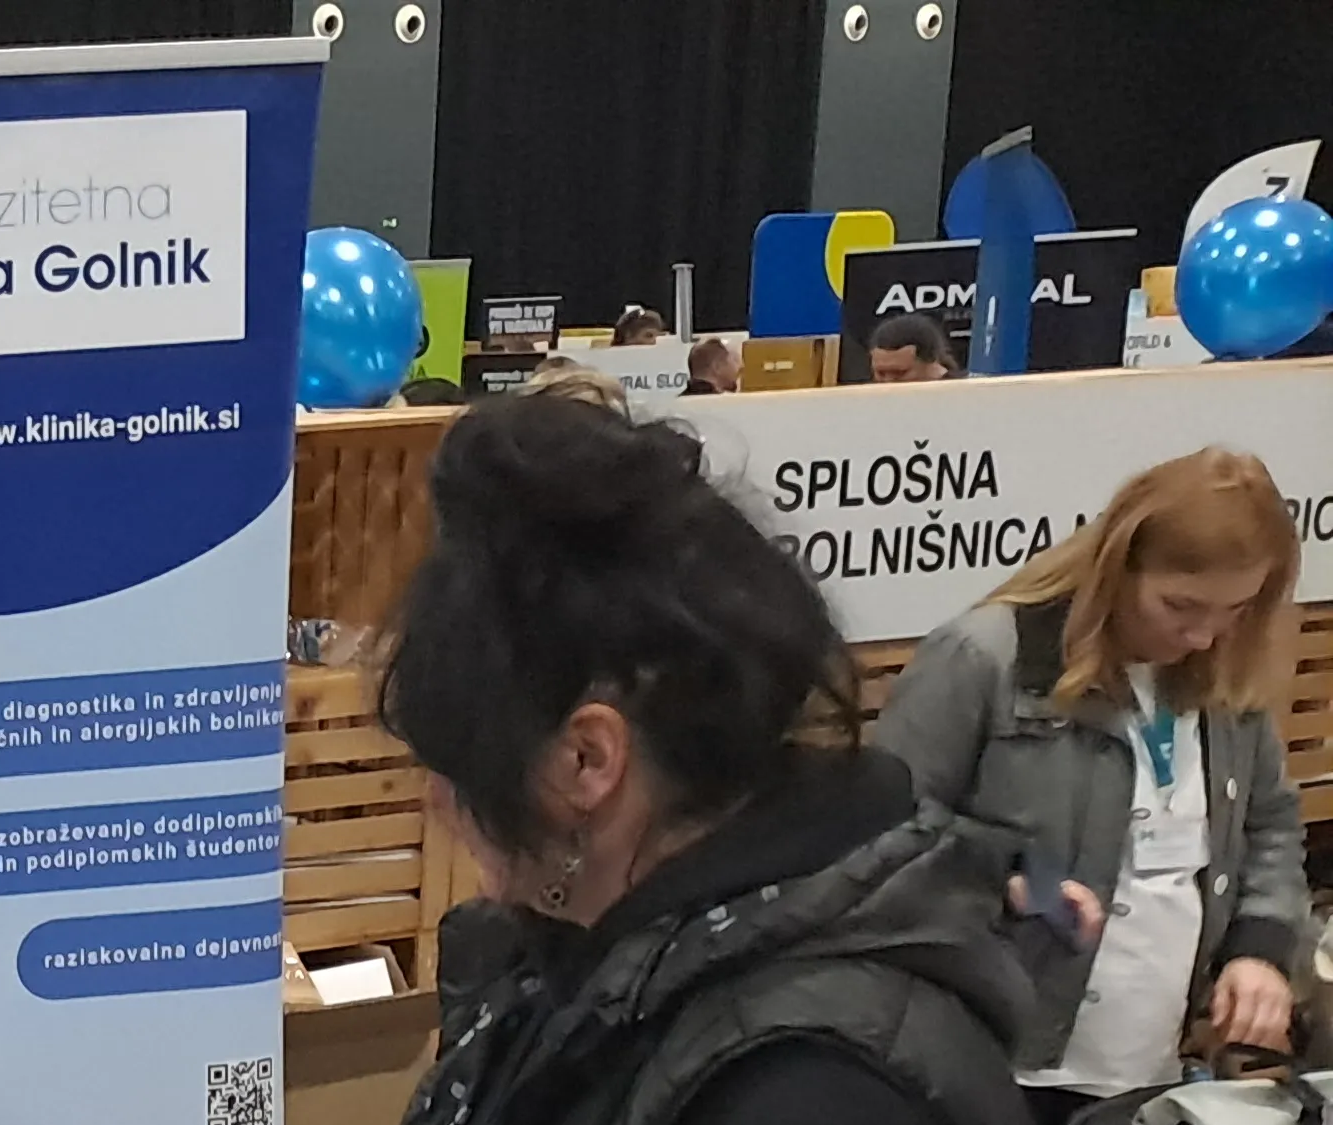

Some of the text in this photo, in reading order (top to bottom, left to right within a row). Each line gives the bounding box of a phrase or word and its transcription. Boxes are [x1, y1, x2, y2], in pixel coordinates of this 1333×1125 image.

[34, 239, 211, 293] Golnik
[876, 274, 1092, 315] ADMAL
[774, 440, 999, 512] SPLOŠNA
[2, 682, 282, 723] diagnostika in zdravljenje
[51, 725, 71, 744] in
[80, 712, 201, 741] alergijskih
[27, 844, 177, 876] podiplomskih
[44, 942, 186, 969] raziskovalna
